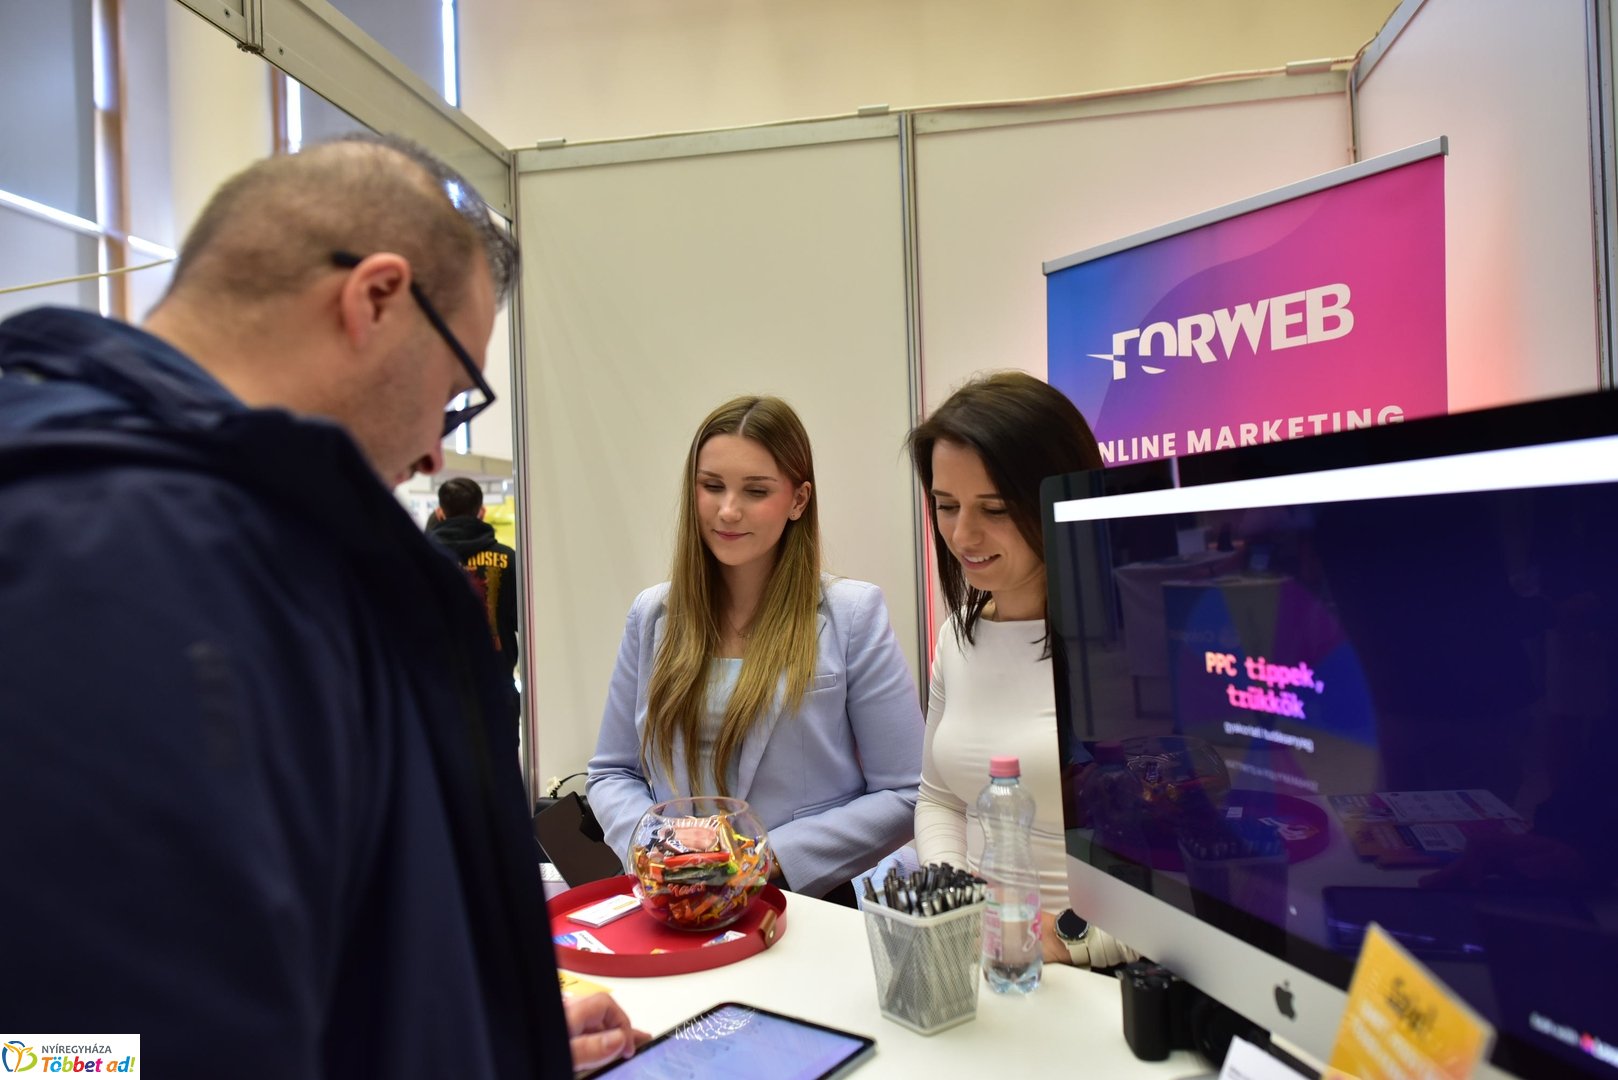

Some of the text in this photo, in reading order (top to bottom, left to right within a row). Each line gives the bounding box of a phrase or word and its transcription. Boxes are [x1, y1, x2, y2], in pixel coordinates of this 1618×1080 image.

[1087, 283, 1355, 380] FORWEB
[1098, 405, 1404, 463] NLINE MARKETING
[1205, 651, 1238, 677] PPC
